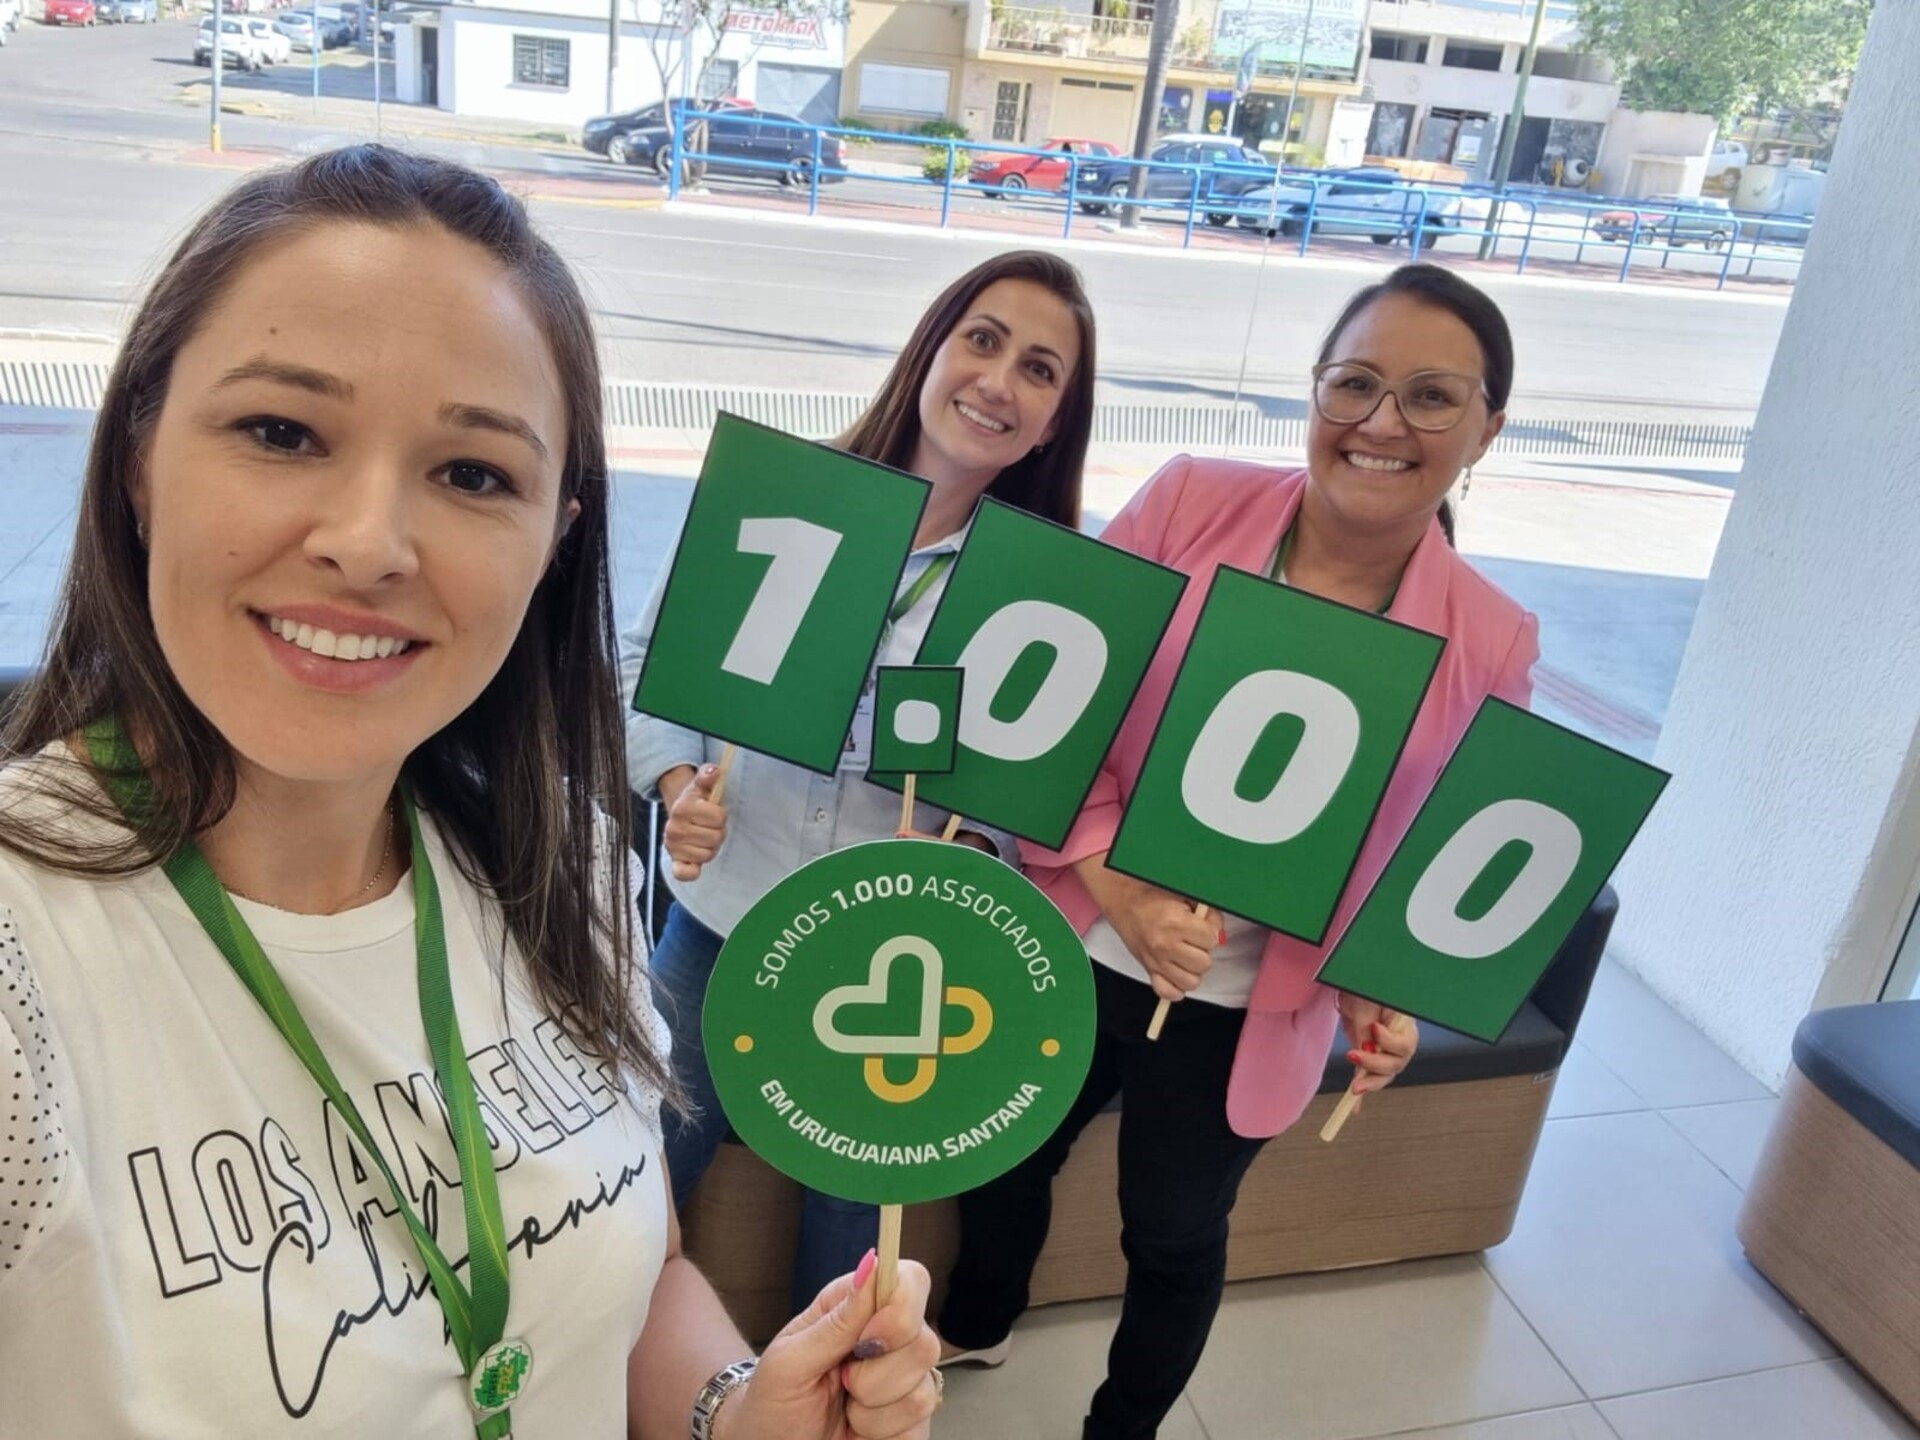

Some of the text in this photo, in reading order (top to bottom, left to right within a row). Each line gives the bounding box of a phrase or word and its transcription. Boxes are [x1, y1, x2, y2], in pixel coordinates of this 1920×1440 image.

[755, 874, 1057, 993] SOMOS 1.000 ASSOCIADOS
[759, 1079, 1042, 1165] EM URUGUAIANA SANTANA
[128, 1117, 331, 1299] LOS
[262, 1153, 646, 1419] Califrnia
